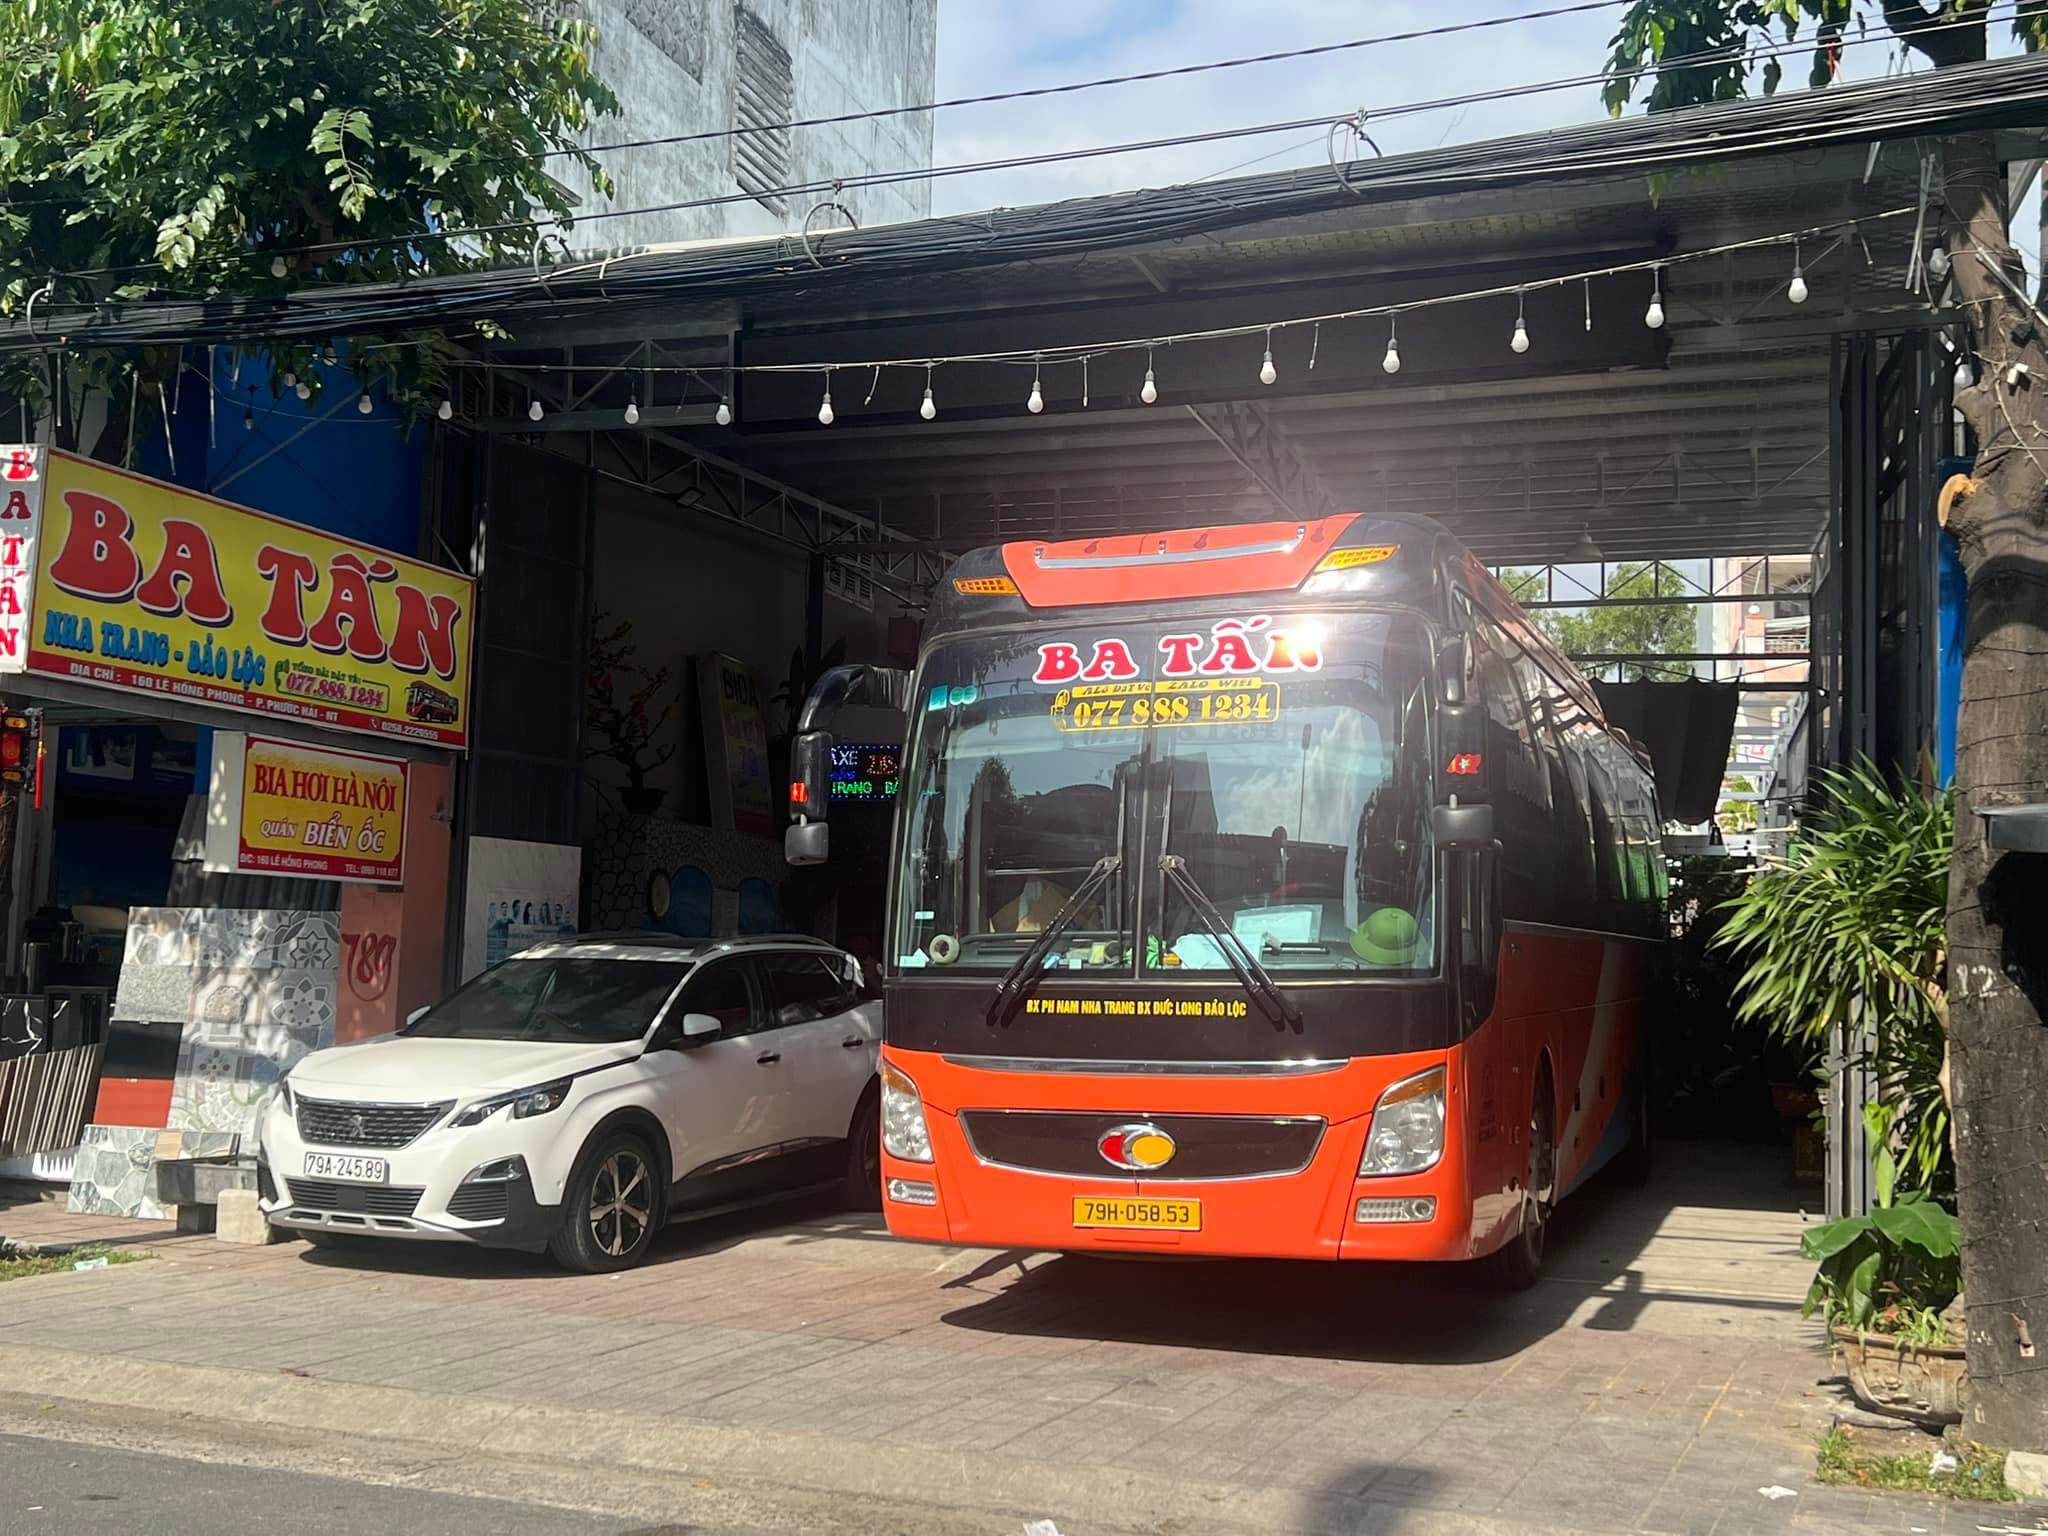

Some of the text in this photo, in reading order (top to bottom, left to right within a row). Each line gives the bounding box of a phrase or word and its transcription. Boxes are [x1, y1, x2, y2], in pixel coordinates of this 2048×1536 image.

[50, 490, 460, 678] BA TẤN
[44, 610, 93, 652] NHA
[101, 621, 169, 667] TRANG
[232, 645, 266, 690] LỘC
[1032, 638, 1139, 684] BA
[132, 674, 153, 688] 160
[207, 688, 244, 704] PHONG
[1074, 692, 1271, 728] 077 888 1234
[253, 764, 289, 797] BIA
[332, 771, 360, 808] HÀ
[362, 777, 397, 818] NỘI
[260, 811, 385, 853] QUÁN BIỂN ỐC
[1026, 999, 1041, 1014] BX
[1056, 999, 1079, 1014] NAM
[1081, 999, 1101, 1015] NHA
[1104, 1000, 1135, 1015] TRANG
[1137, 1001, 1151, 1015] BX
[1175, 1001, 1202, 1016] LONG
[1204, 998, 1225, 1017] BẢO
[1227, 999, 1247, 1018] LỘC
[308, 1155, 383, 1179] 79A-245.89
[1084, 1203, 1190, 1223] 79H-058.53
